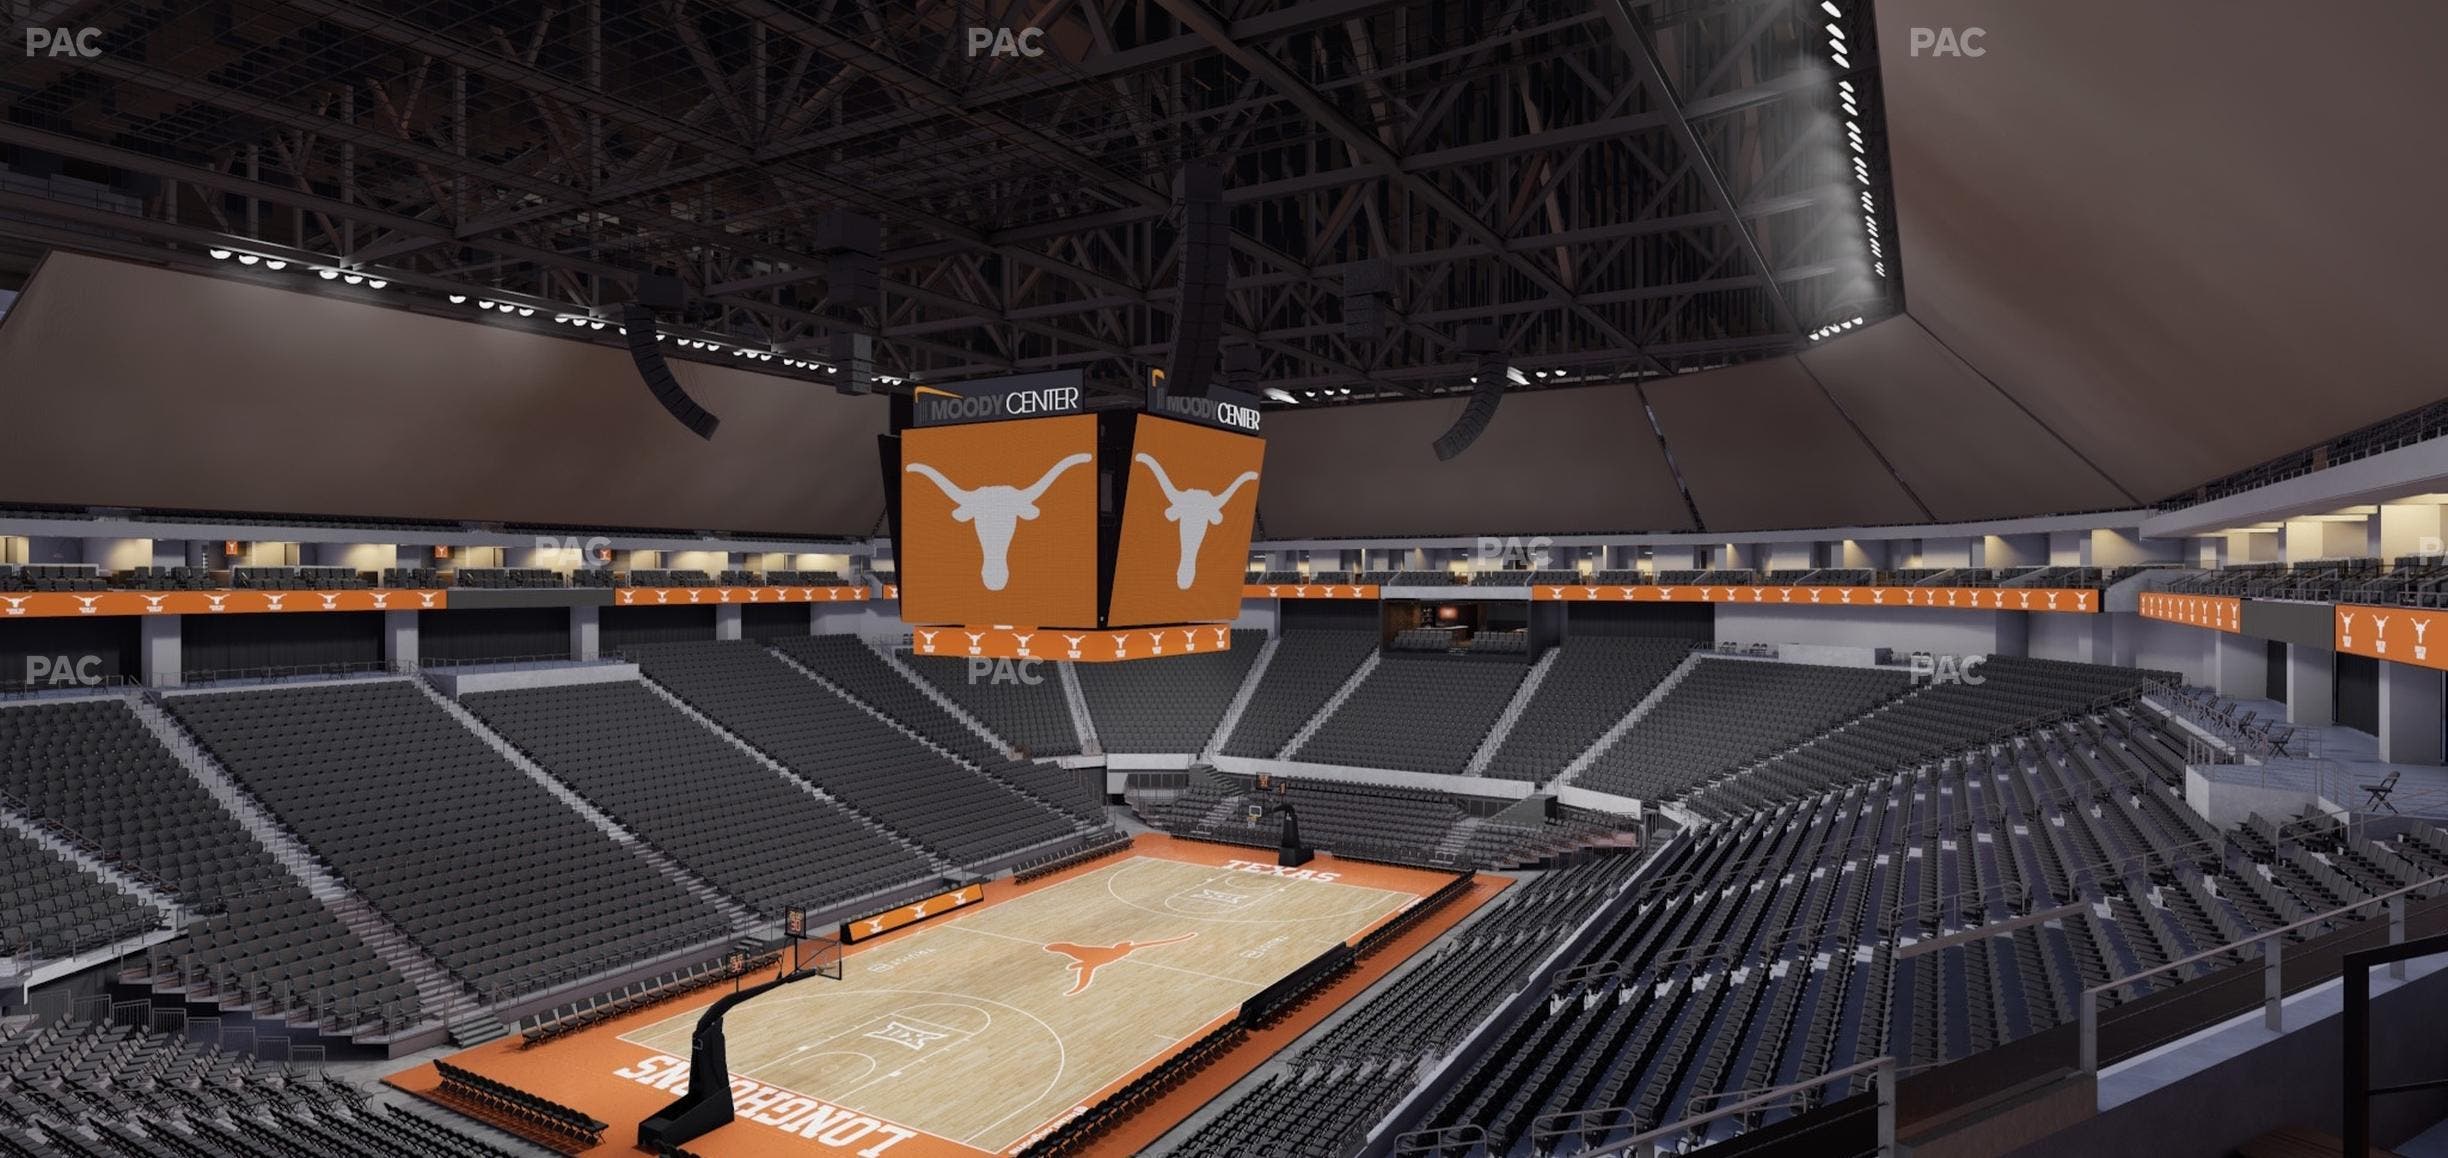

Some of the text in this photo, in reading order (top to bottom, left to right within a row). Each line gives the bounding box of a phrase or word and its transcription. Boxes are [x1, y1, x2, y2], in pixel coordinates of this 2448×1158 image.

[931, 387, 1079, 420] MOODY CENTER
[1167, 396, 1260, 431] MOODY CENTER
[1222, 860, 1342, 882] TEXAS
[612, 1054, 918, 1158] LONGHNS
